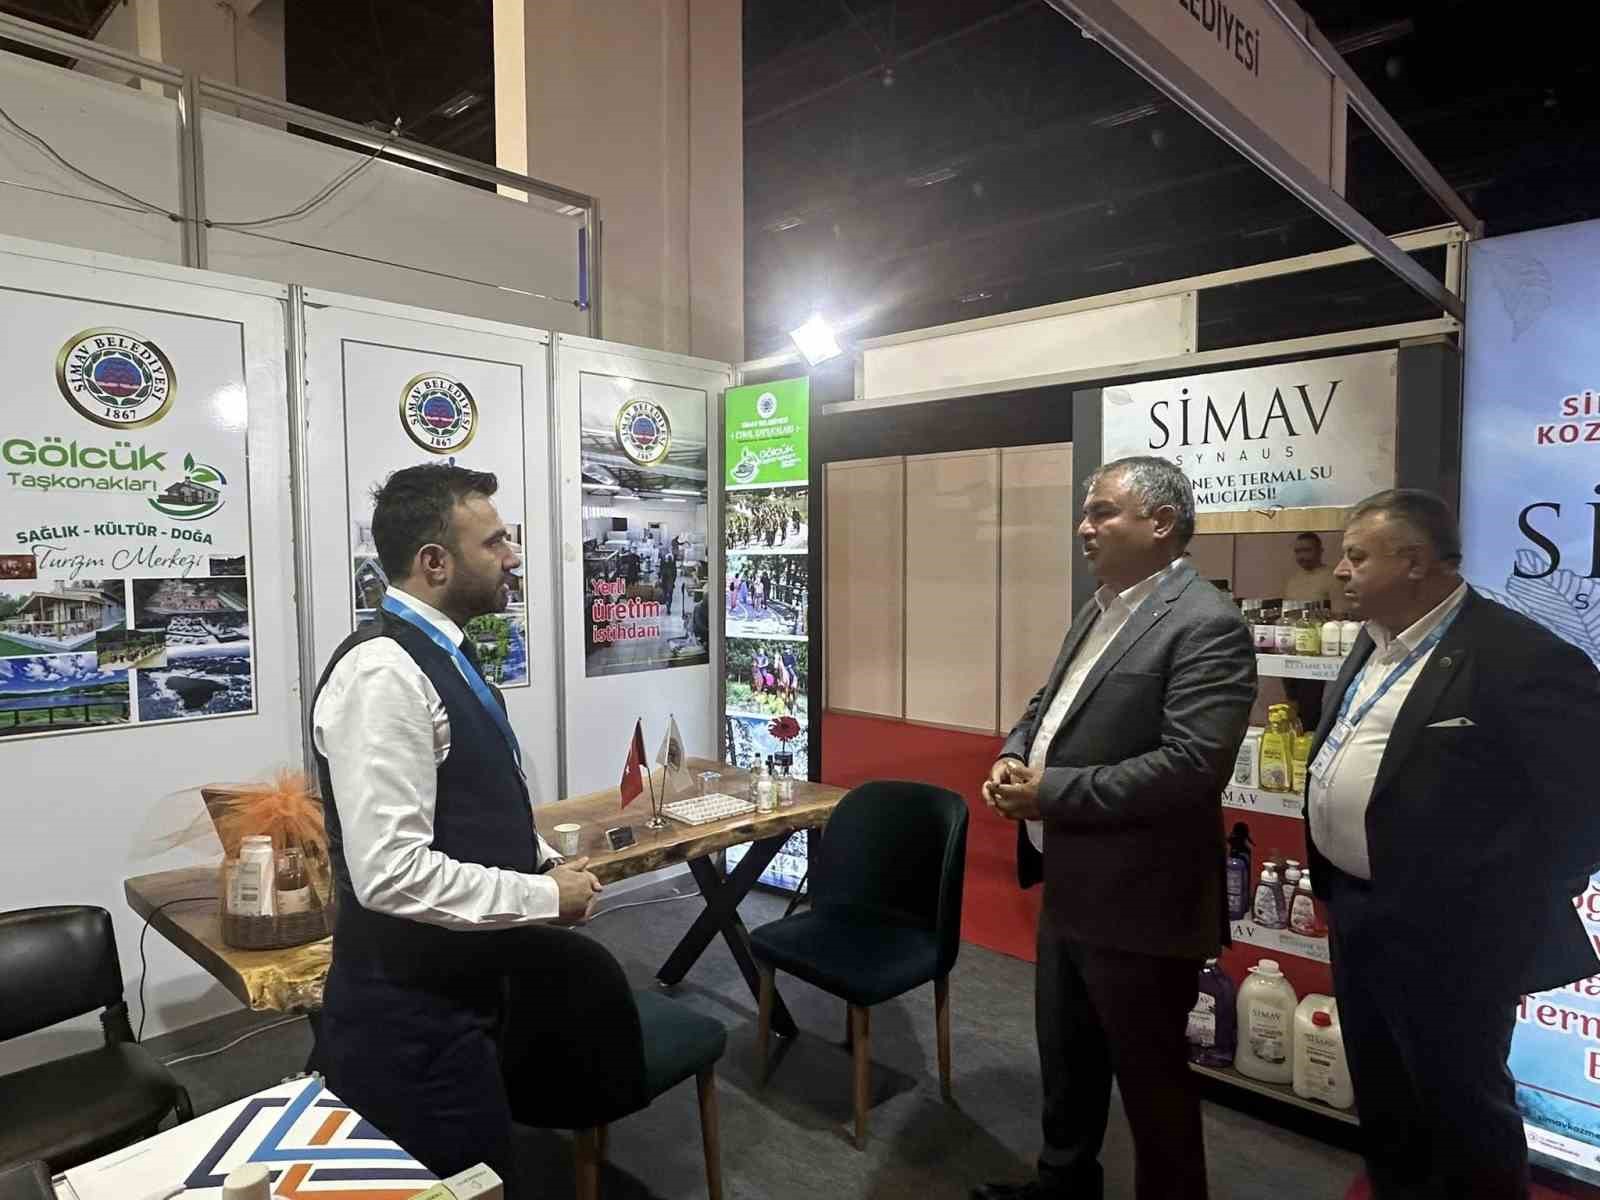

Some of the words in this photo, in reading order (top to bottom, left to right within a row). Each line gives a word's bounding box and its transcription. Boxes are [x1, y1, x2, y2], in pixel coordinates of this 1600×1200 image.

[104, 407, 137, 420] 1867
[1149, 380, 1343, 449] SİMAV
[1563, 392, 1600, 416] Sİ
[2, 436, 168, 471] Gölcük
[1176, 446, 1294, 466] SYNAUS
[7, 471, 157, 491] Taşkonakları
[1192, 476, 1213, 490] NE
[1216, 474, 1236, 488] VE
[1240, 468, 1306, 486] TERMAL
[1310, 465, 1333, 480] SU
[16, 525, 80, 544] SAĞLIK
[94, 521, 157, 537] KÜLTÜR
[171, 527, 213, 545] DOĞA
[32, 543, 104, 580] Turizm
[112, 543, 203, 577] Merkezi
[592, 578, 626, 596] Yerli
[593, 597, 661, 621] üretim
[593, 623, 660, 642] istihdam
[1220, 790, 1257, 804] MAV
